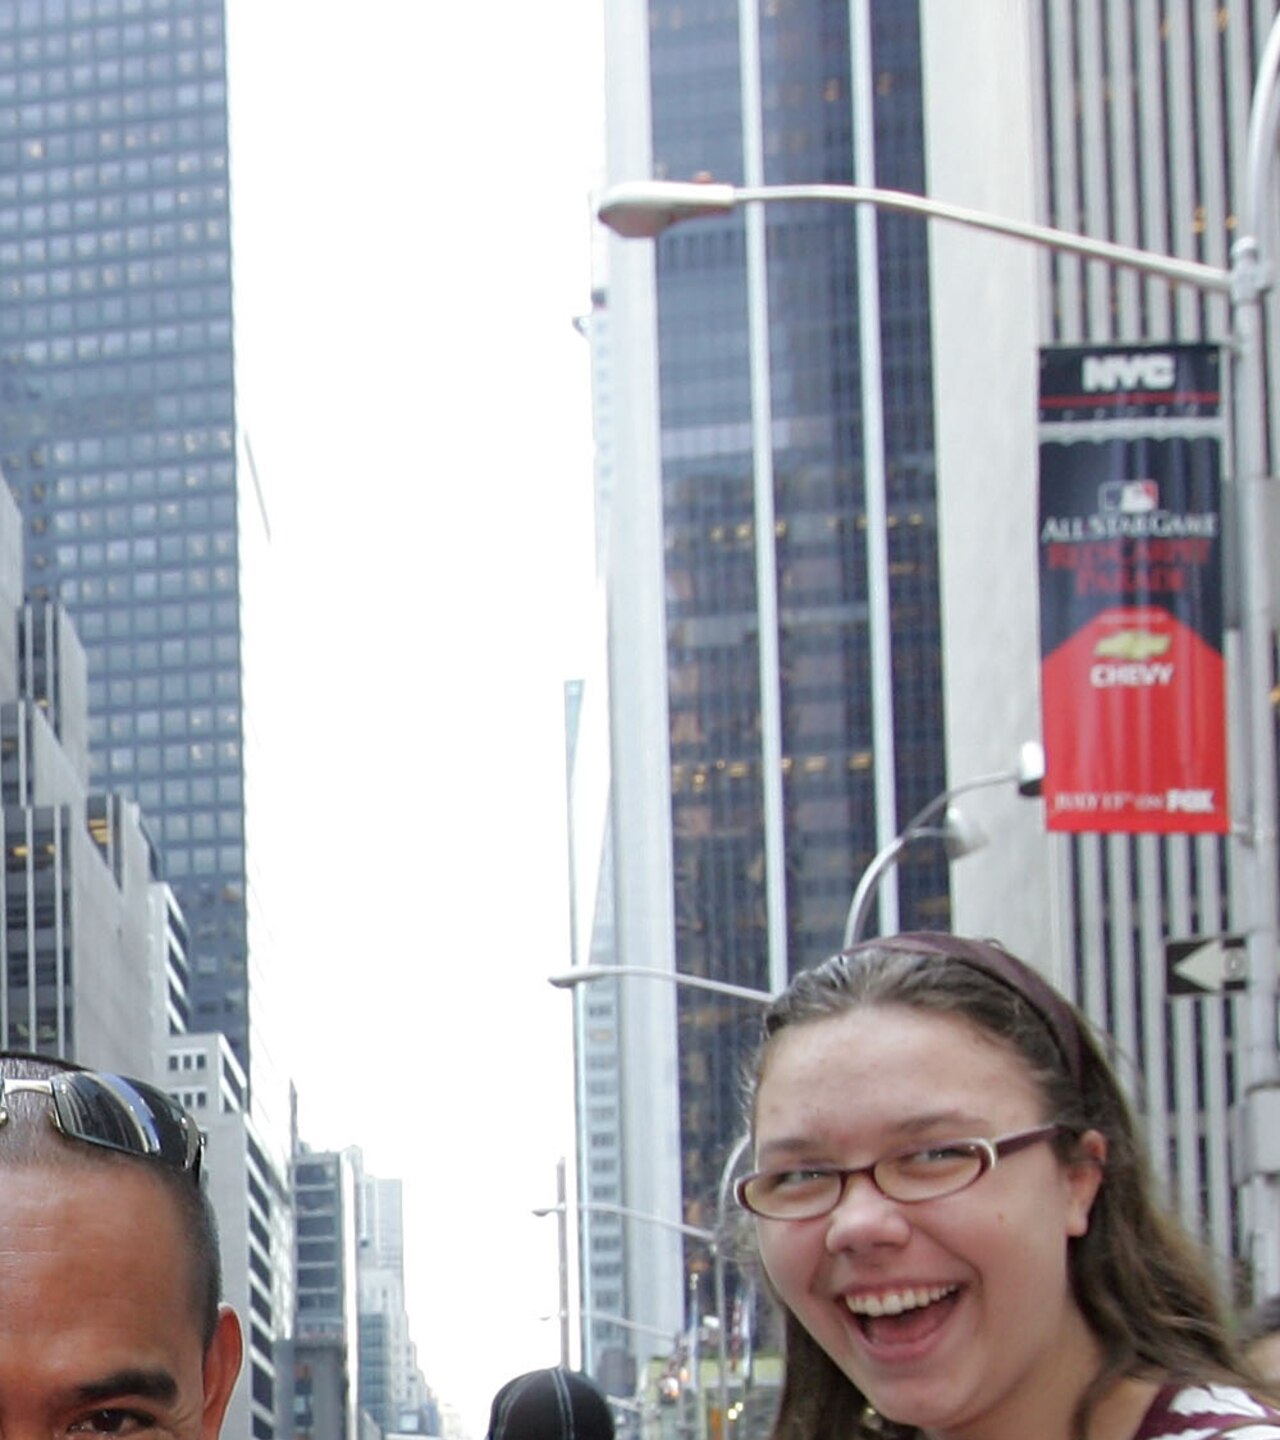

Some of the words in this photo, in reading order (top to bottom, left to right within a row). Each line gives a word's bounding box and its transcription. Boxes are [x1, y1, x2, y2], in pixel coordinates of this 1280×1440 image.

[1082, 353, 1174, 391] NYC
[1041, 515, 1084, 543] ALL
[1149, 509, 1216, 538] GAME
[1090, 663, 1174, 687] CHEVY
[1167, 788, 1215, 813] FOX
